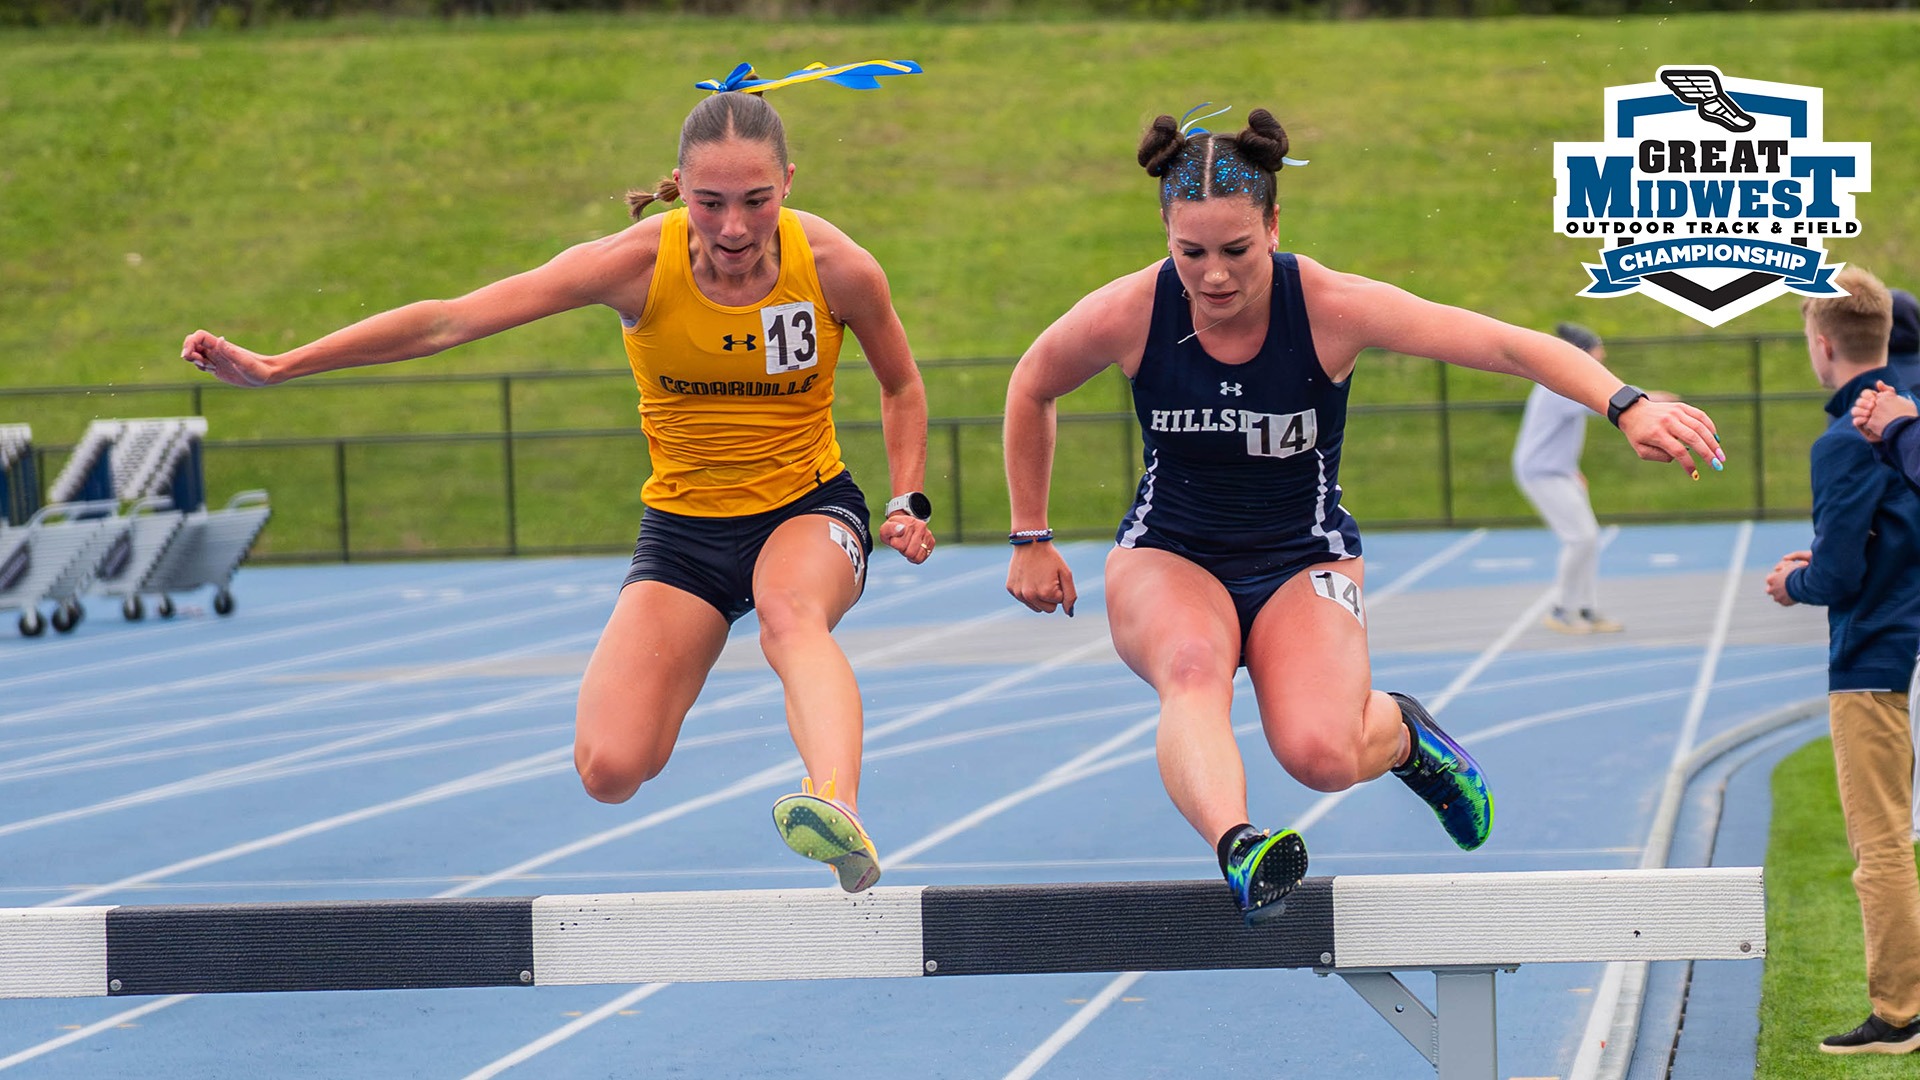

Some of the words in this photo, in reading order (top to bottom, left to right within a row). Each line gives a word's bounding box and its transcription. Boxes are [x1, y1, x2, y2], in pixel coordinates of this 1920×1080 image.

[768, 310, 816, 366] 13
[659, 373, 819, 396] CEDARVILLE
[1251, 414, 1308, 455] 14
[1315, 571, 1360, 616] 14
